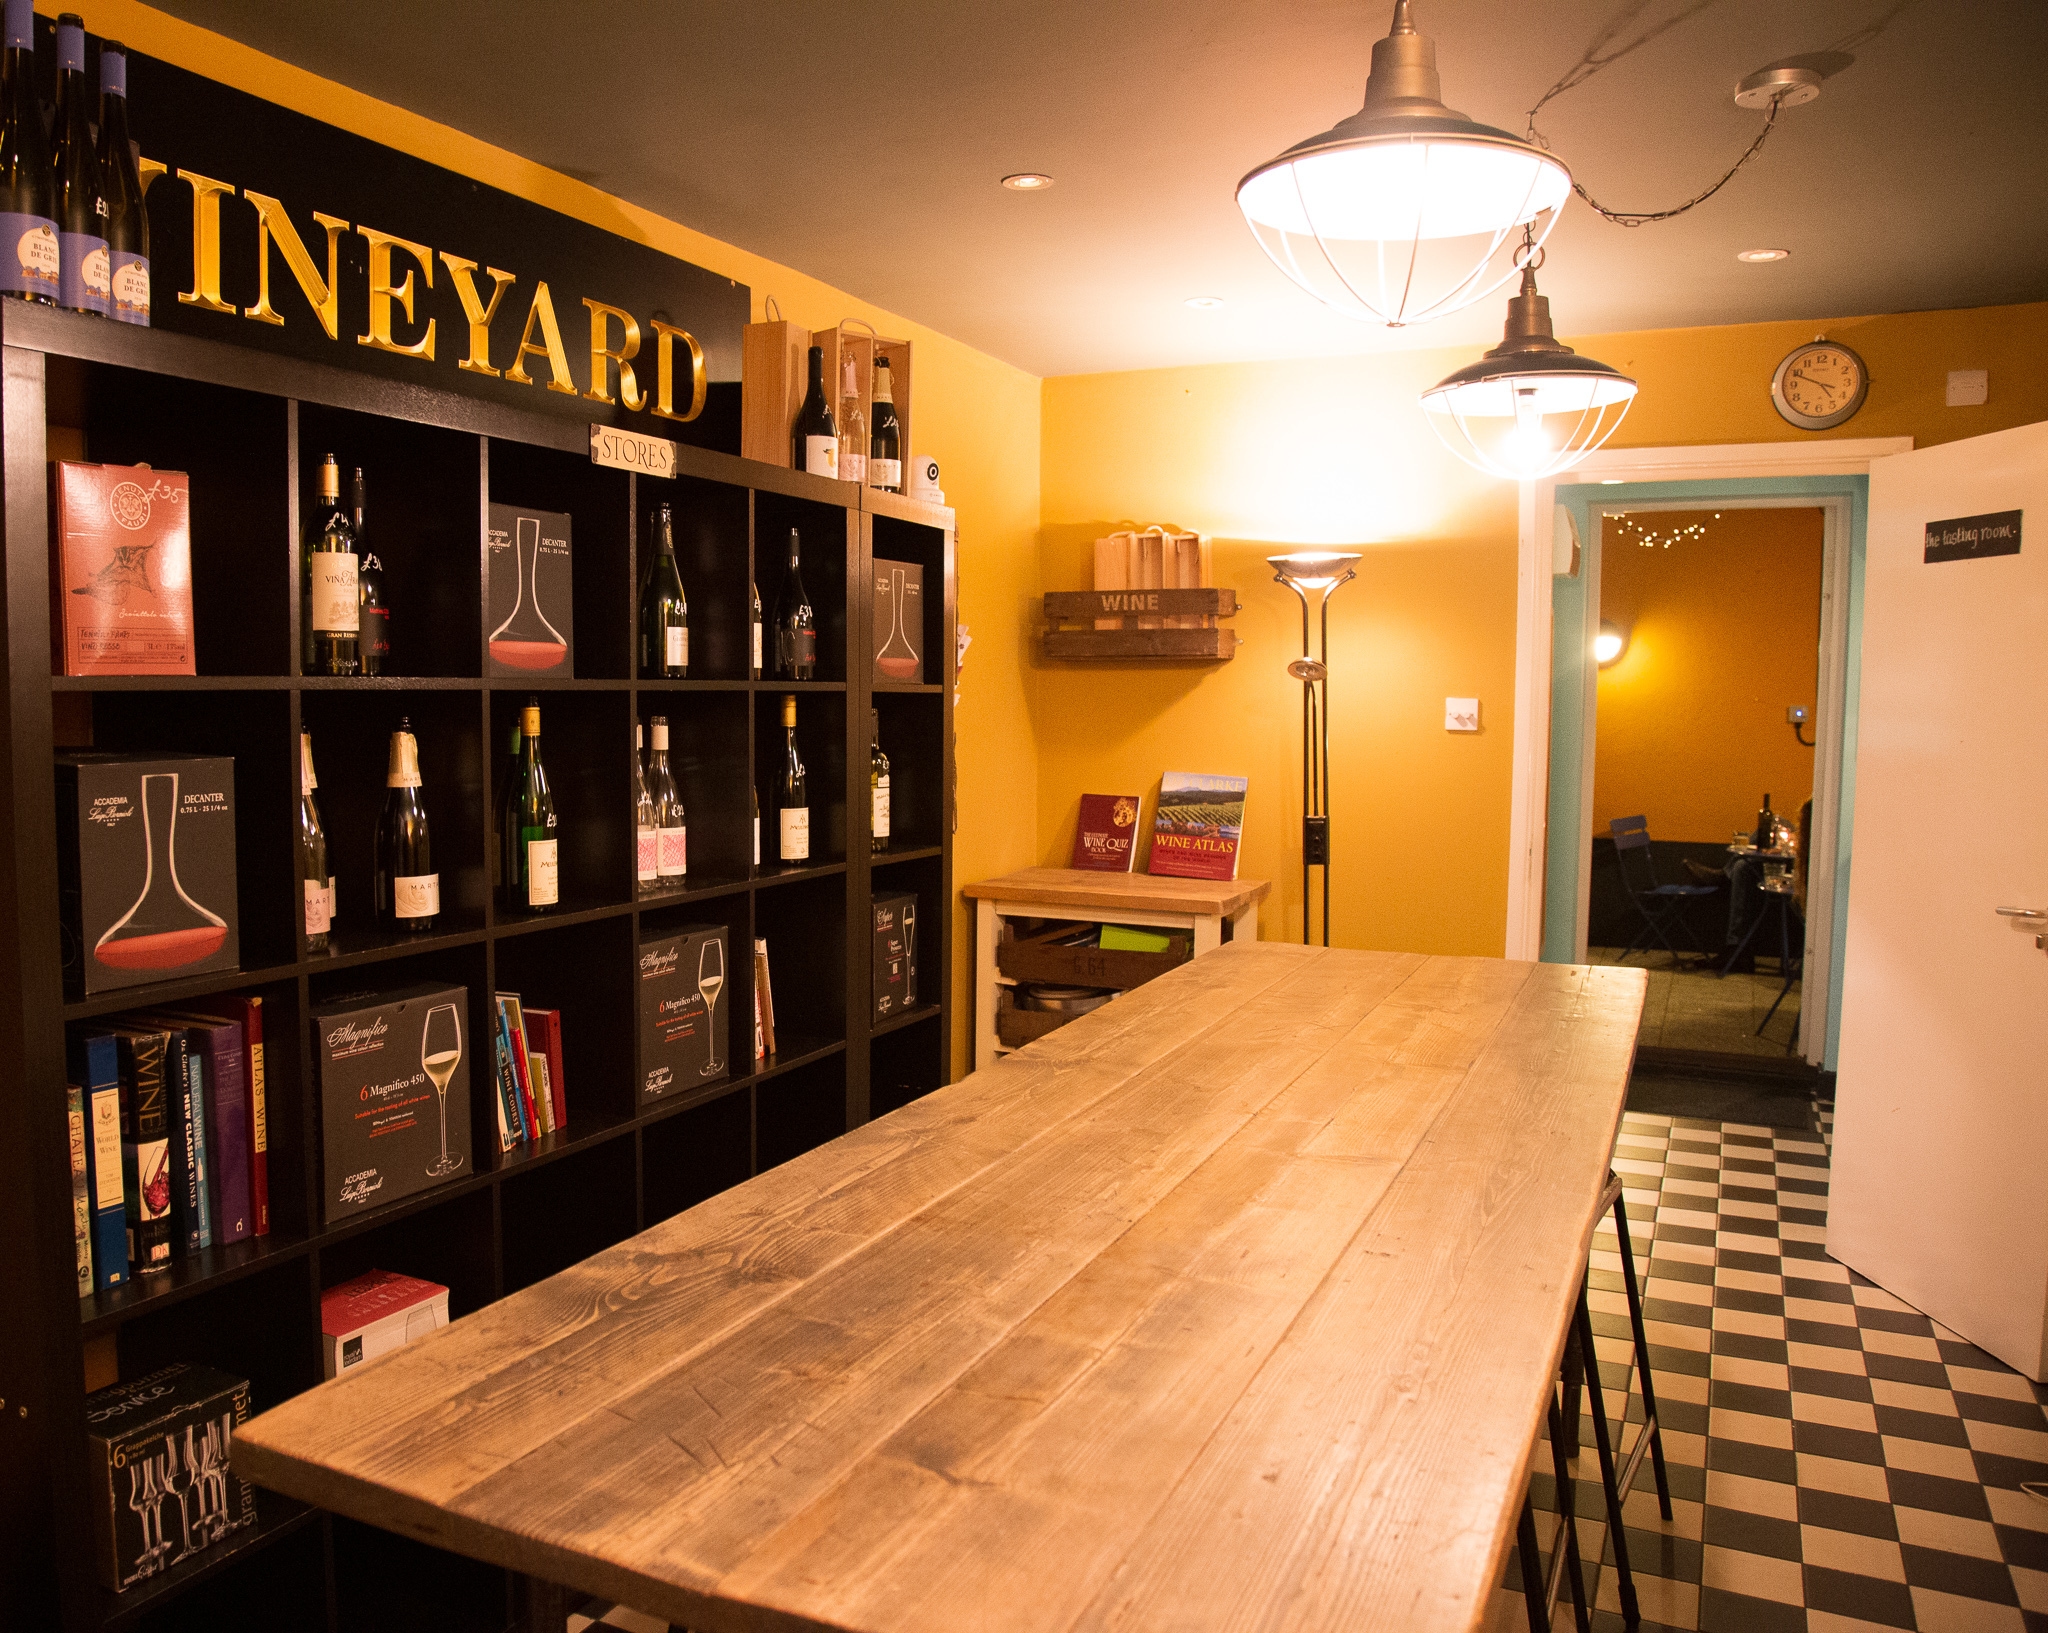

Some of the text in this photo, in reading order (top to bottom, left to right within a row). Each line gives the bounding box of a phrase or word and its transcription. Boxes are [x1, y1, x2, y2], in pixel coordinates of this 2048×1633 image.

[1816, 354, 1828, 364] 12
[1841, 365, 1849, 375] 2
[602, 434, 667, 471] STORES
[121, 511, 148, 528] FAURI
[542, 537, 567, 548] DECANTER
[1943, 527, 1978, 550] tasting
[1101, 593, 1159, 612] WINE
[94, 796, 128, 806] ACCADEMIA
[184, 793, 224, 804] DECANTER
[180, 806, 193, 814] 0.75
[1084, 837, 1129, 852] WINE QUIZ
[1155, 834, 1234, 854] WINE ATLAS
[659, 1000, 665, 1014] 6
[665, 997, 691, 1011] Magnifico
[327, 1017, 388, 1049] Magnifico
[137, 1045, 161, 1131] WINE
[359, 1084, 369, 1102] 6
[370, 1079, 409, 1098] Magnifico
[410, 1072, 425, 1086] 450
[184, 1093, 192, 1120] NEW
[191, 1064, 203, 1150] NATURAL WINE
[254, 1046, 266, 1152] ATLAS WINE
[503, 1068, 513, 1093] WINE
[508, 1092, 519, 1127] COURSE
[96, 1133, 119, 1144] WORLD
[185, 1122, 195, 1170] CLASSIC
[99, 1145, 117, 1154] WINE
[344, 1168, 378, 1185] ACCADEMIA
[189, 1172, 197, 1208] WINES
[152, 1245, 169, 1259] DK
[113, 1444, 126, 1469] 6
